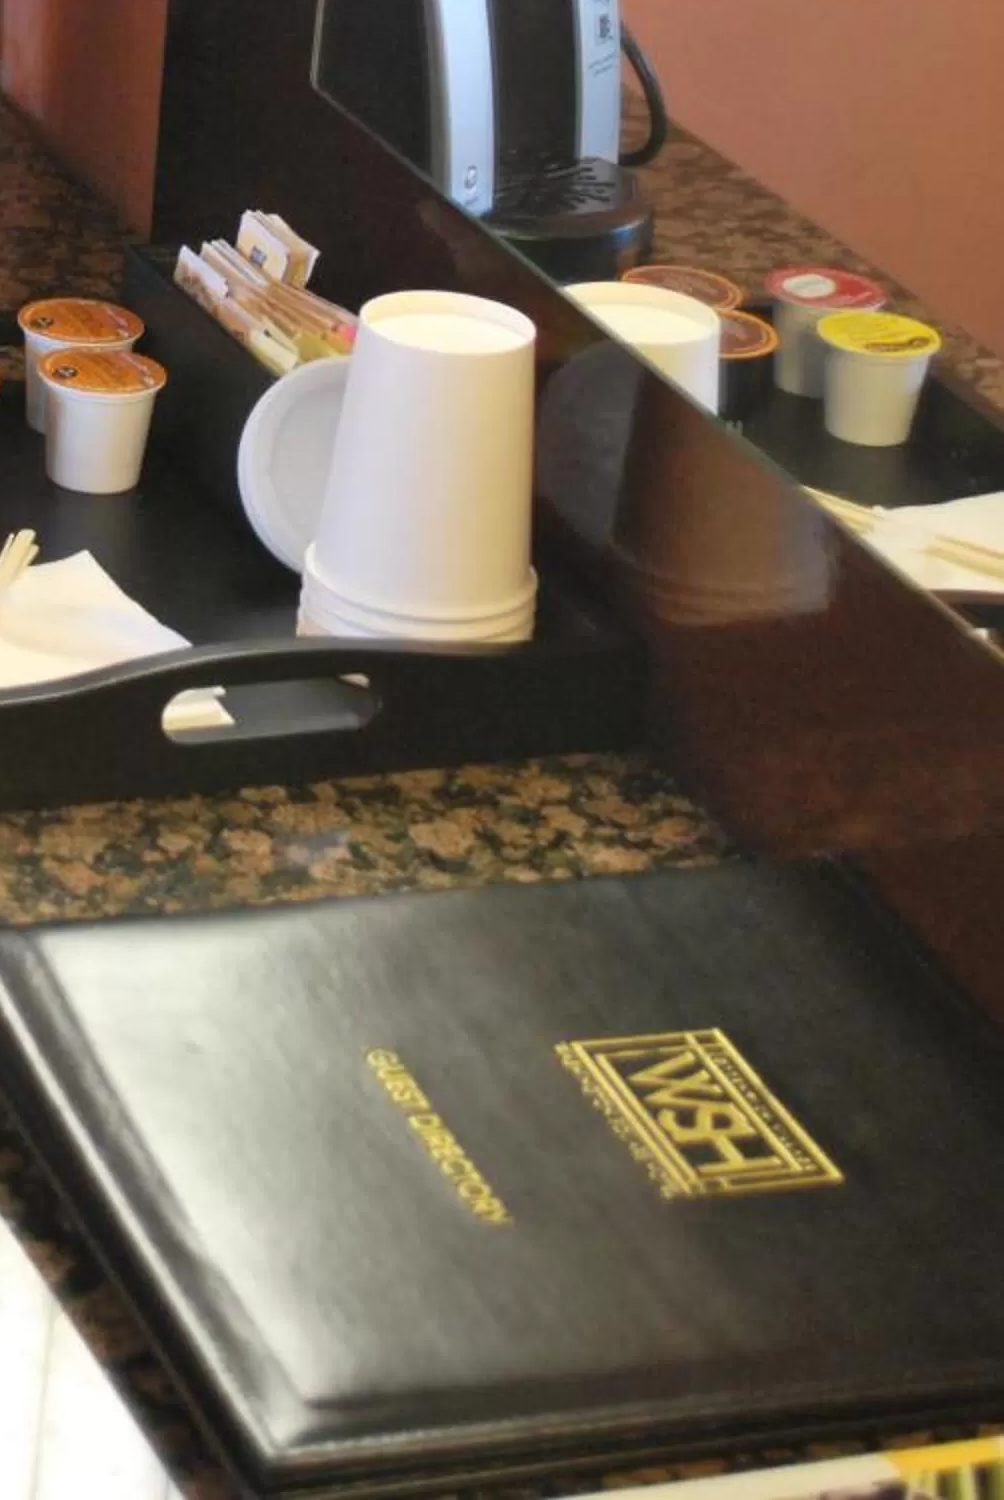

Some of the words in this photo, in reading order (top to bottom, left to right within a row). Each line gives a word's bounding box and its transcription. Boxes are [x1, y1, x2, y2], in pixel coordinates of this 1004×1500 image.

[366, 1048, 430, 1109] GUEST
[408, 1112, 512, 1222] DIRECTORY
[627, 1051, 783, 1175] WSH
